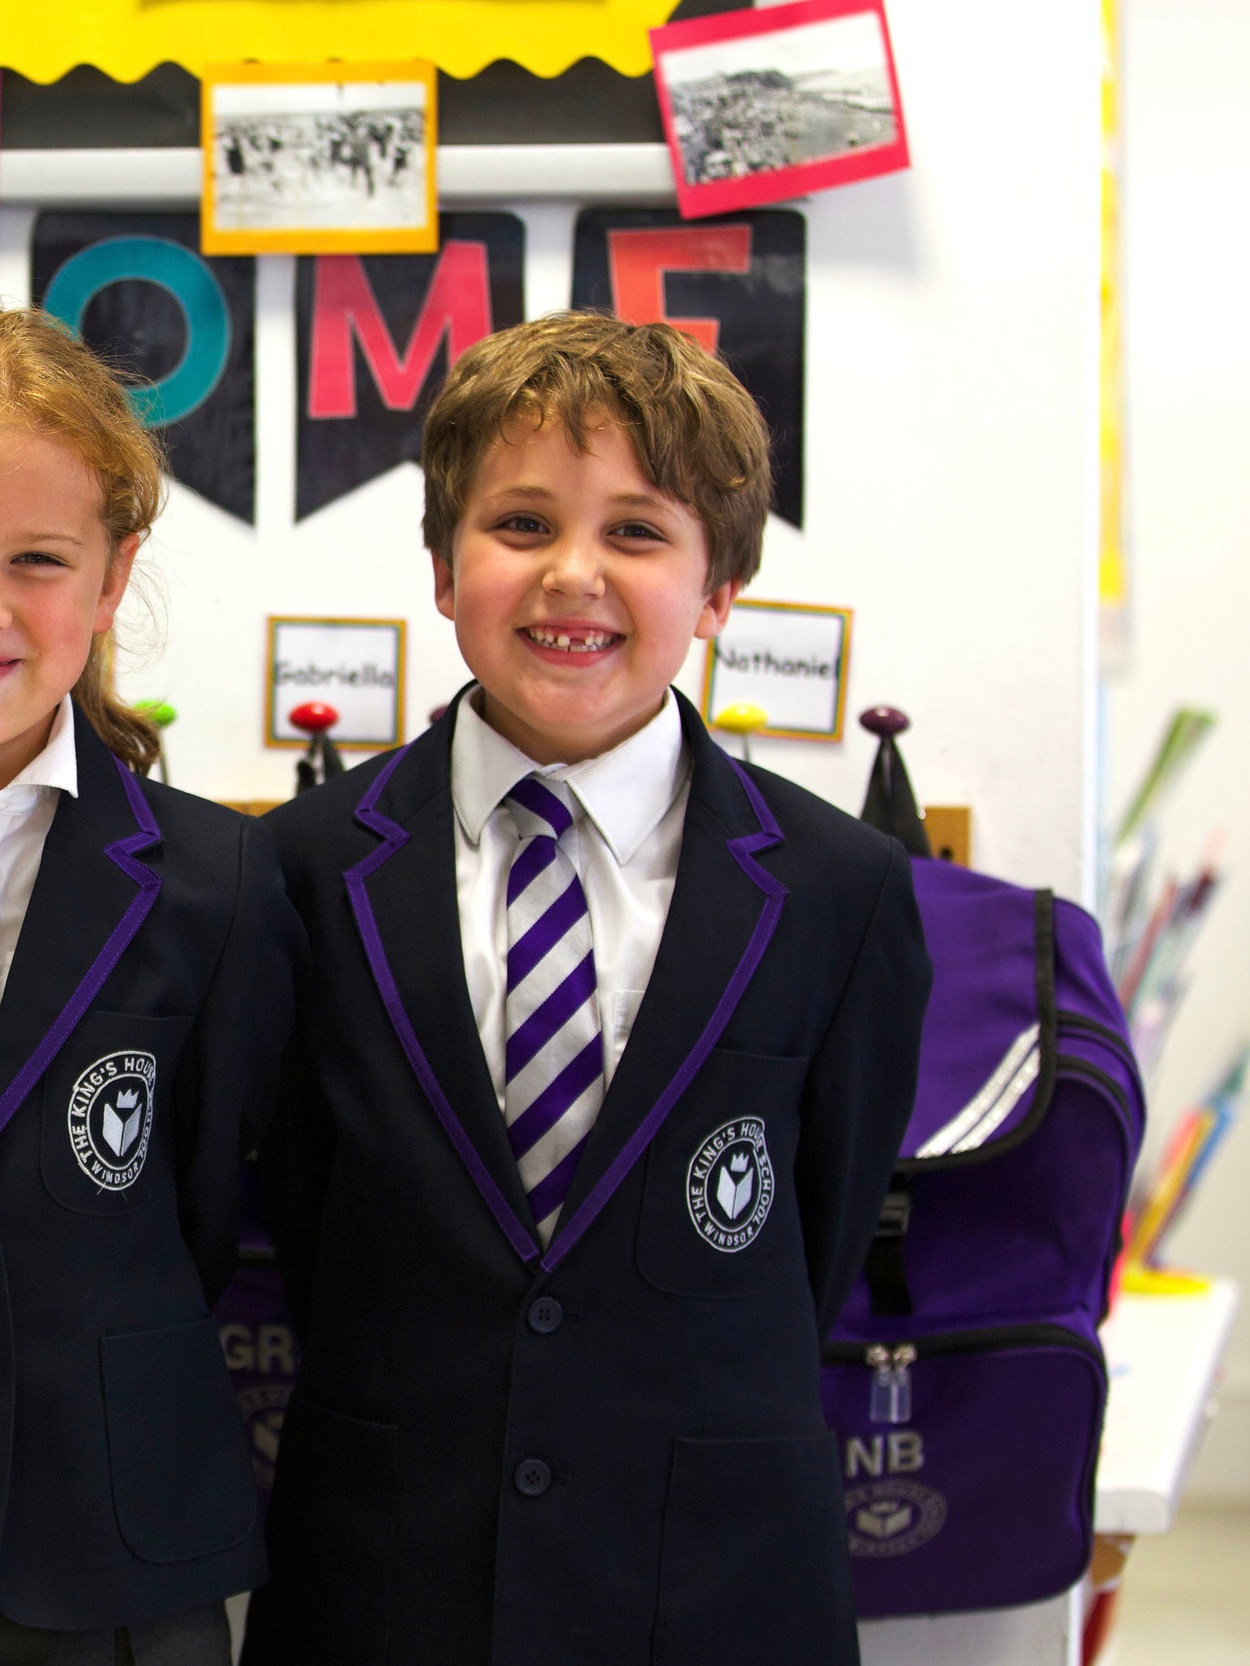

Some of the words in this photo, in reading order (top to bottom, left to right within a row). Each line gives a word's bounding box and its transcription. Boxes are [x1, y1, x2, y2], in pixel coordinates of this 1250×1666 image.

[274, 661, 395, 688] Gabriella
[714, 645, 840, 680] Nathaniel
[71, 1061, 118, 1118] KING'S
[72, 1124, 94, 1164] THE
[692, 1127, 736, 1180] KING'S
[91, 1160, 139, 1185] WINDSOR
[752, 1154, 772, 1225] SCHOOL
[690, 1185, 707, 1224] THE
[703, 1221, 755, 1247] WINDSOR
[218, 1323, 295, 1374] GR
[845, 1431, 925, 1478] NB
